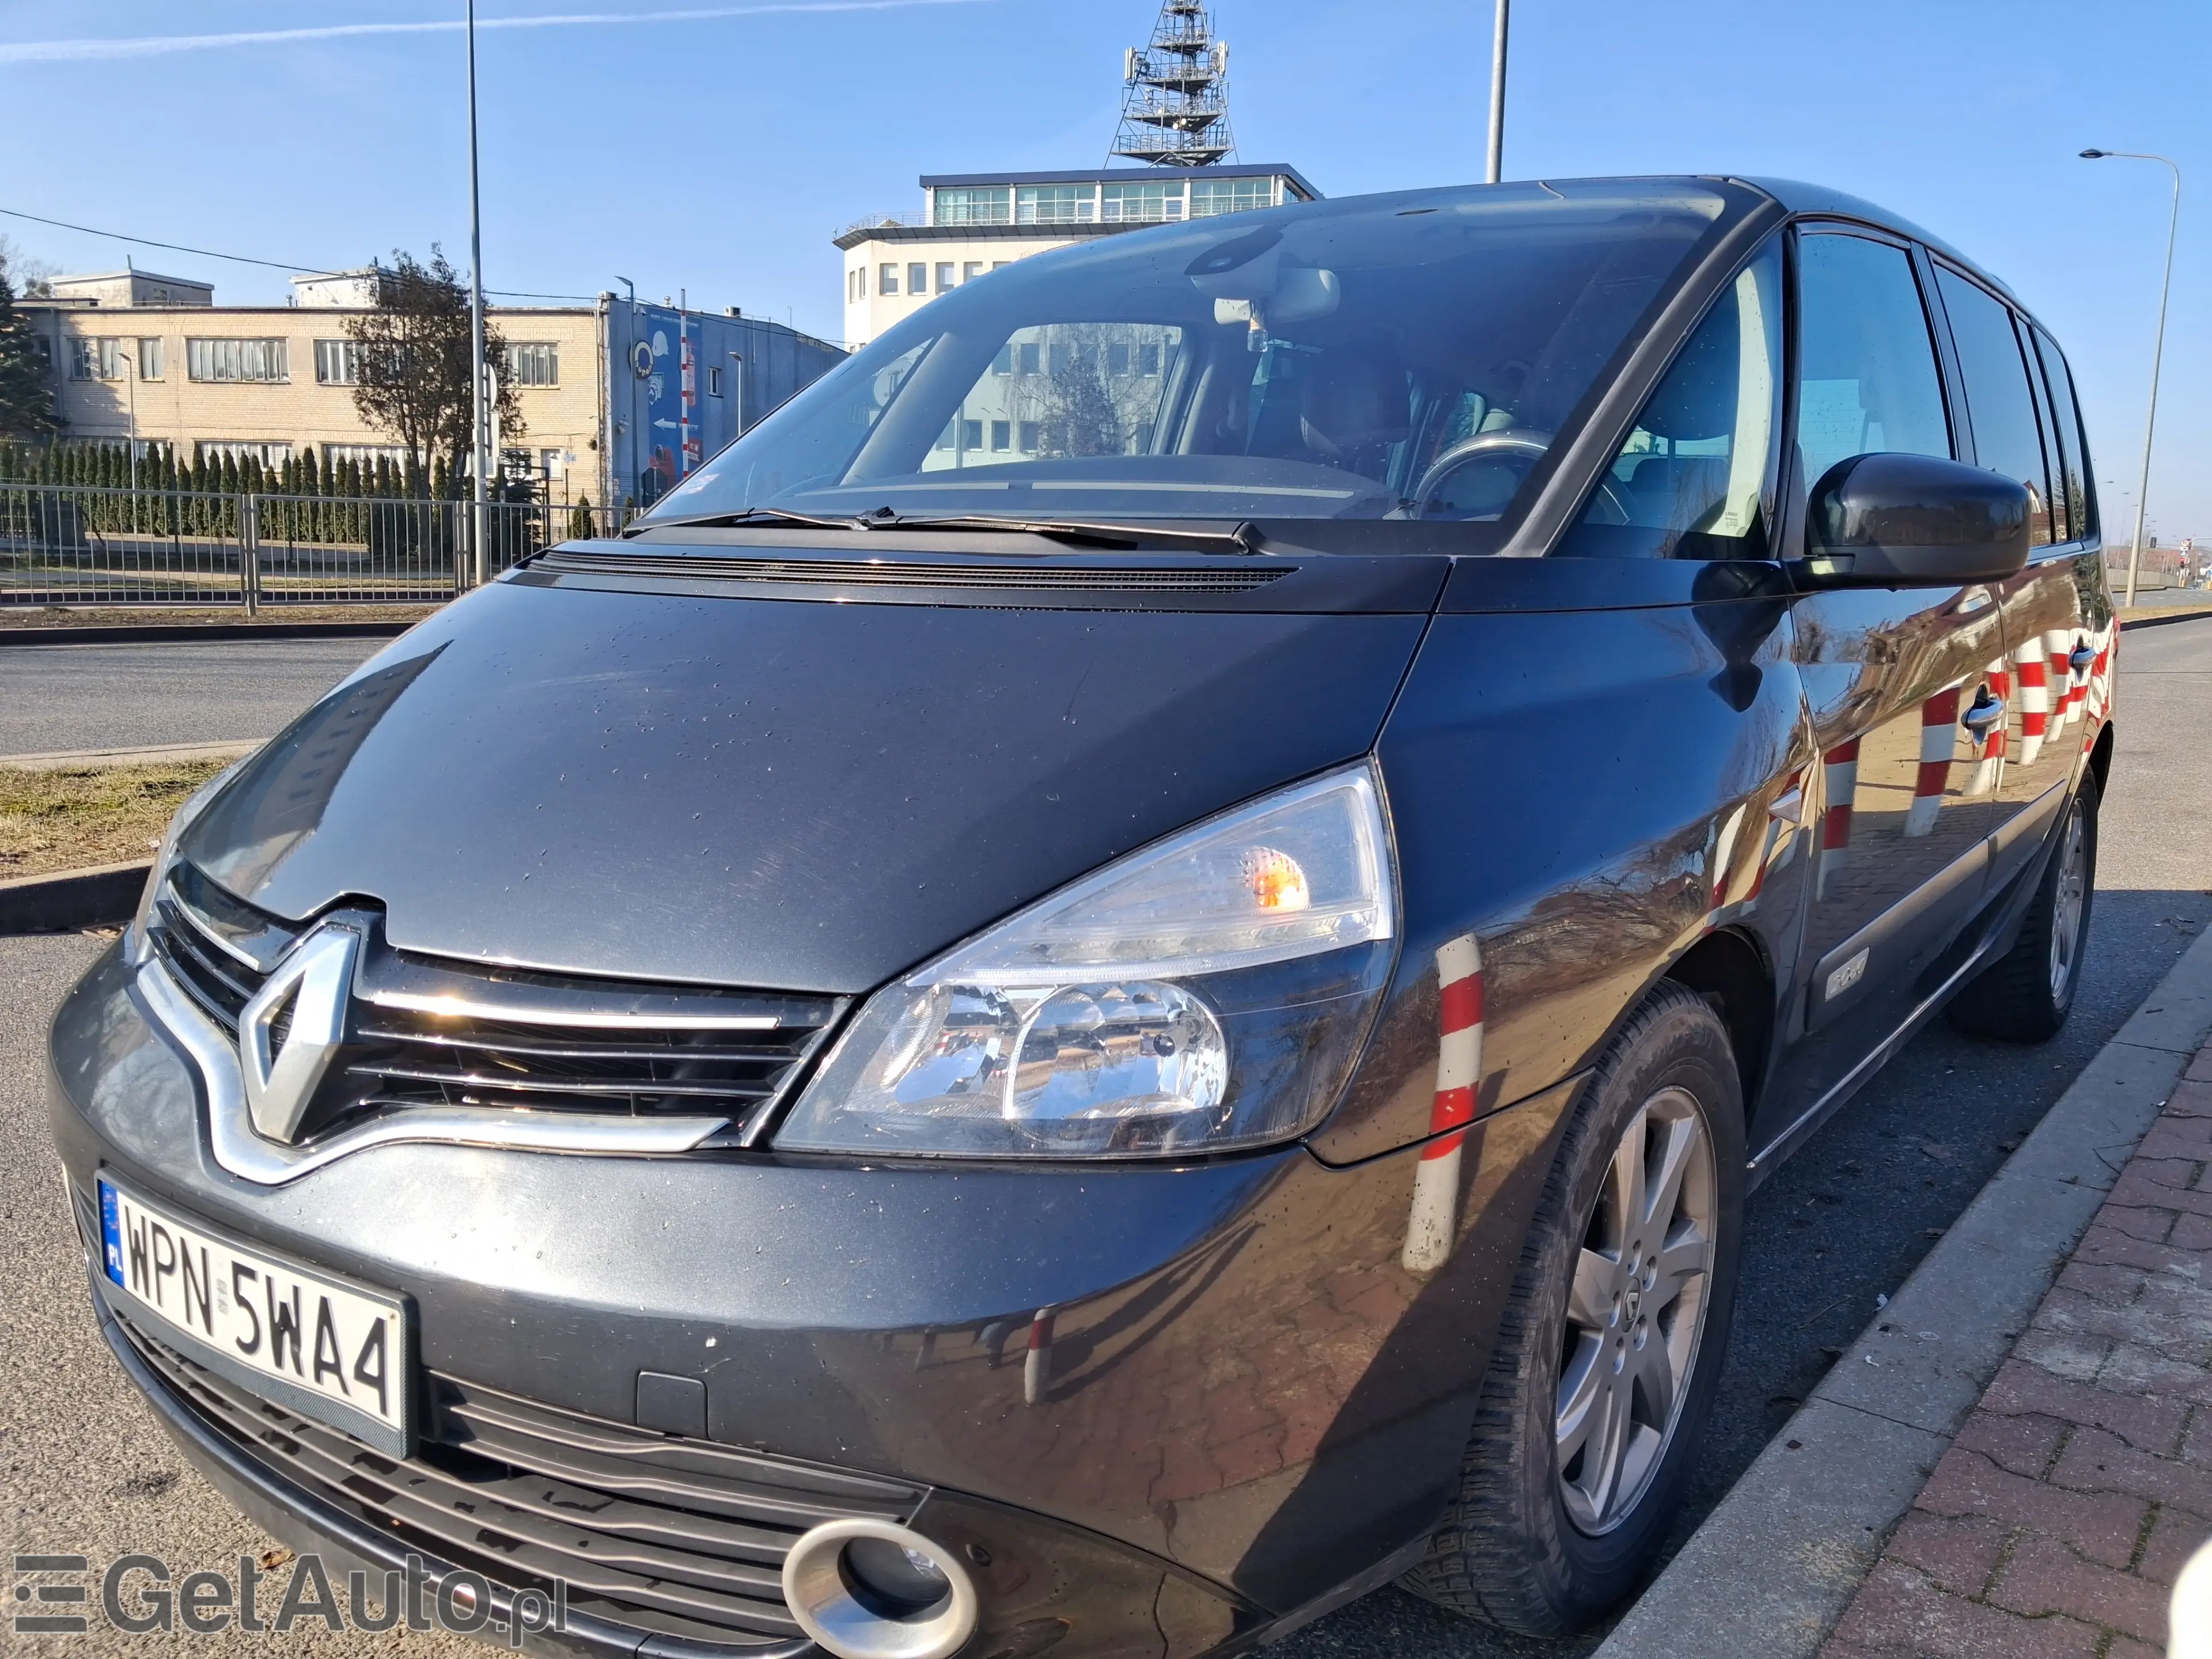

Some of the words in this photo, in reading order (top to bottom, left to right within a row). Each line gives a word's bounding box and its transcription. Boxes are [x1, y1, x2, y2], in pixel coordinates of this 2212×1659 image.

[108, 1242, 123, 1273] PL
[125, 1205, 214, 1337] WPN
[232, 1260, 389, 1418] 5WA4
